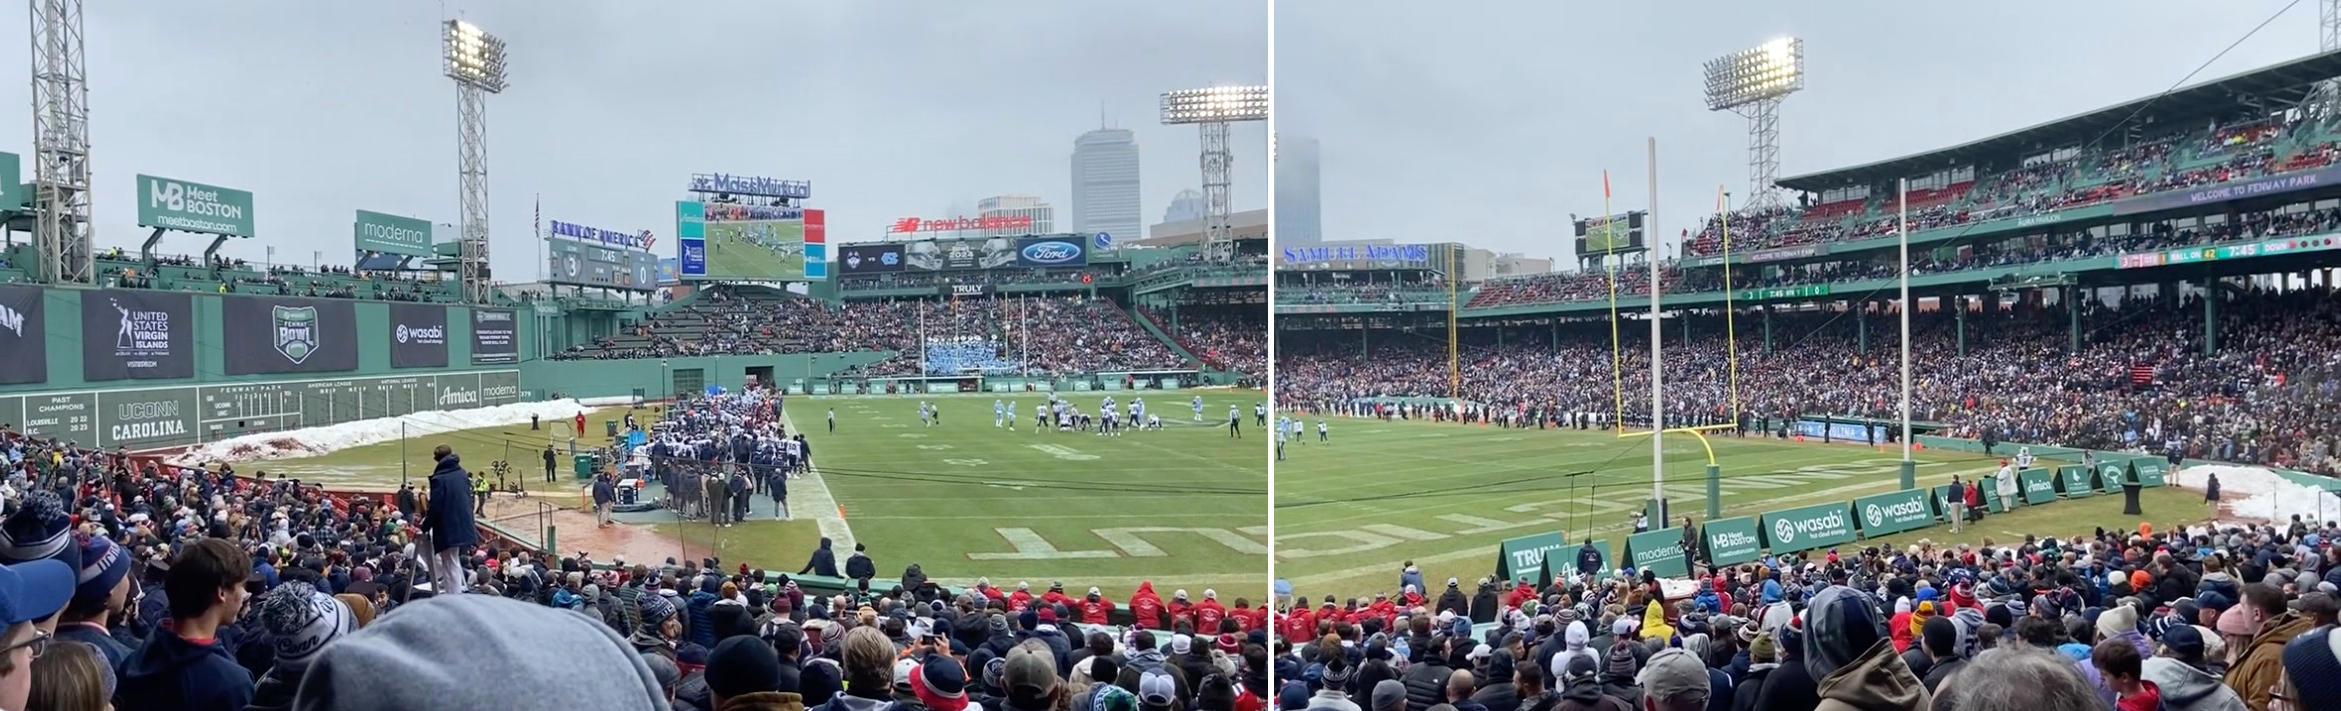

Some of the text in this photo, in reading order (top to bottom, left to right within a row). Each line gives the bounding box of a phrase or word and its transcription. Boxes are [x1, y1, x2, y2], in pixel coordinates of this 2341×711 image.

[714, 172, 810, 198] MassMutual
[2191, 173, 2317, 203] WELCOME TO FENWAY PARK
[187, 185, 218, 202] Meet
[187, 199, 241, 219] BOSTON
[158, 215, 237, 232] meetboston.com
[552, 220, 582, 237] BANK
[583, 226, 598, 239] OF
[924, 219, 955, 231] new
[365, 223, 423, 243] moderna
[601, 249, 616, 262] 7:45
[1034, 245, 1067, 259] Ford
[1284, 244, 1428, 264] SAMUEL ADAMS
[2203, 249, 2216, 259] 42
[2228, 246, 2255, 257] 7:45
[569, 257, 576, 277] 3
[952, 285, 982, 293] TRULY
[132, 311, 168, 321] UNITED
[134, 321, 168, 331] STATES
[409, 325, 442, 339] wasabi
[134, 331, 168, 341] VIRGIN
[280, 327, 314, 346] BOWL
[135, 341, 168, 349] ISLANDS
[439, 386, 477, 405] Amica
[483, 384, 516, 397] moderna
[38, 403, 85, 413] CHAMPIONS
[119, 400, 179, 420] UCONN
[27, 417, 58, 427] LOUISVILLE
[80, 423, 87, 431] 23
[112, 420, 185, 441] CAROLINA
[2028, 480, 2052, 492] Amica
[1881, 496, 1925, 518] wasabi
[1794, 510, 1845, 533] wasabi
[1729, 535, 1757, 546] BOSTON
[1637, 545, 1684, 561] moderna
